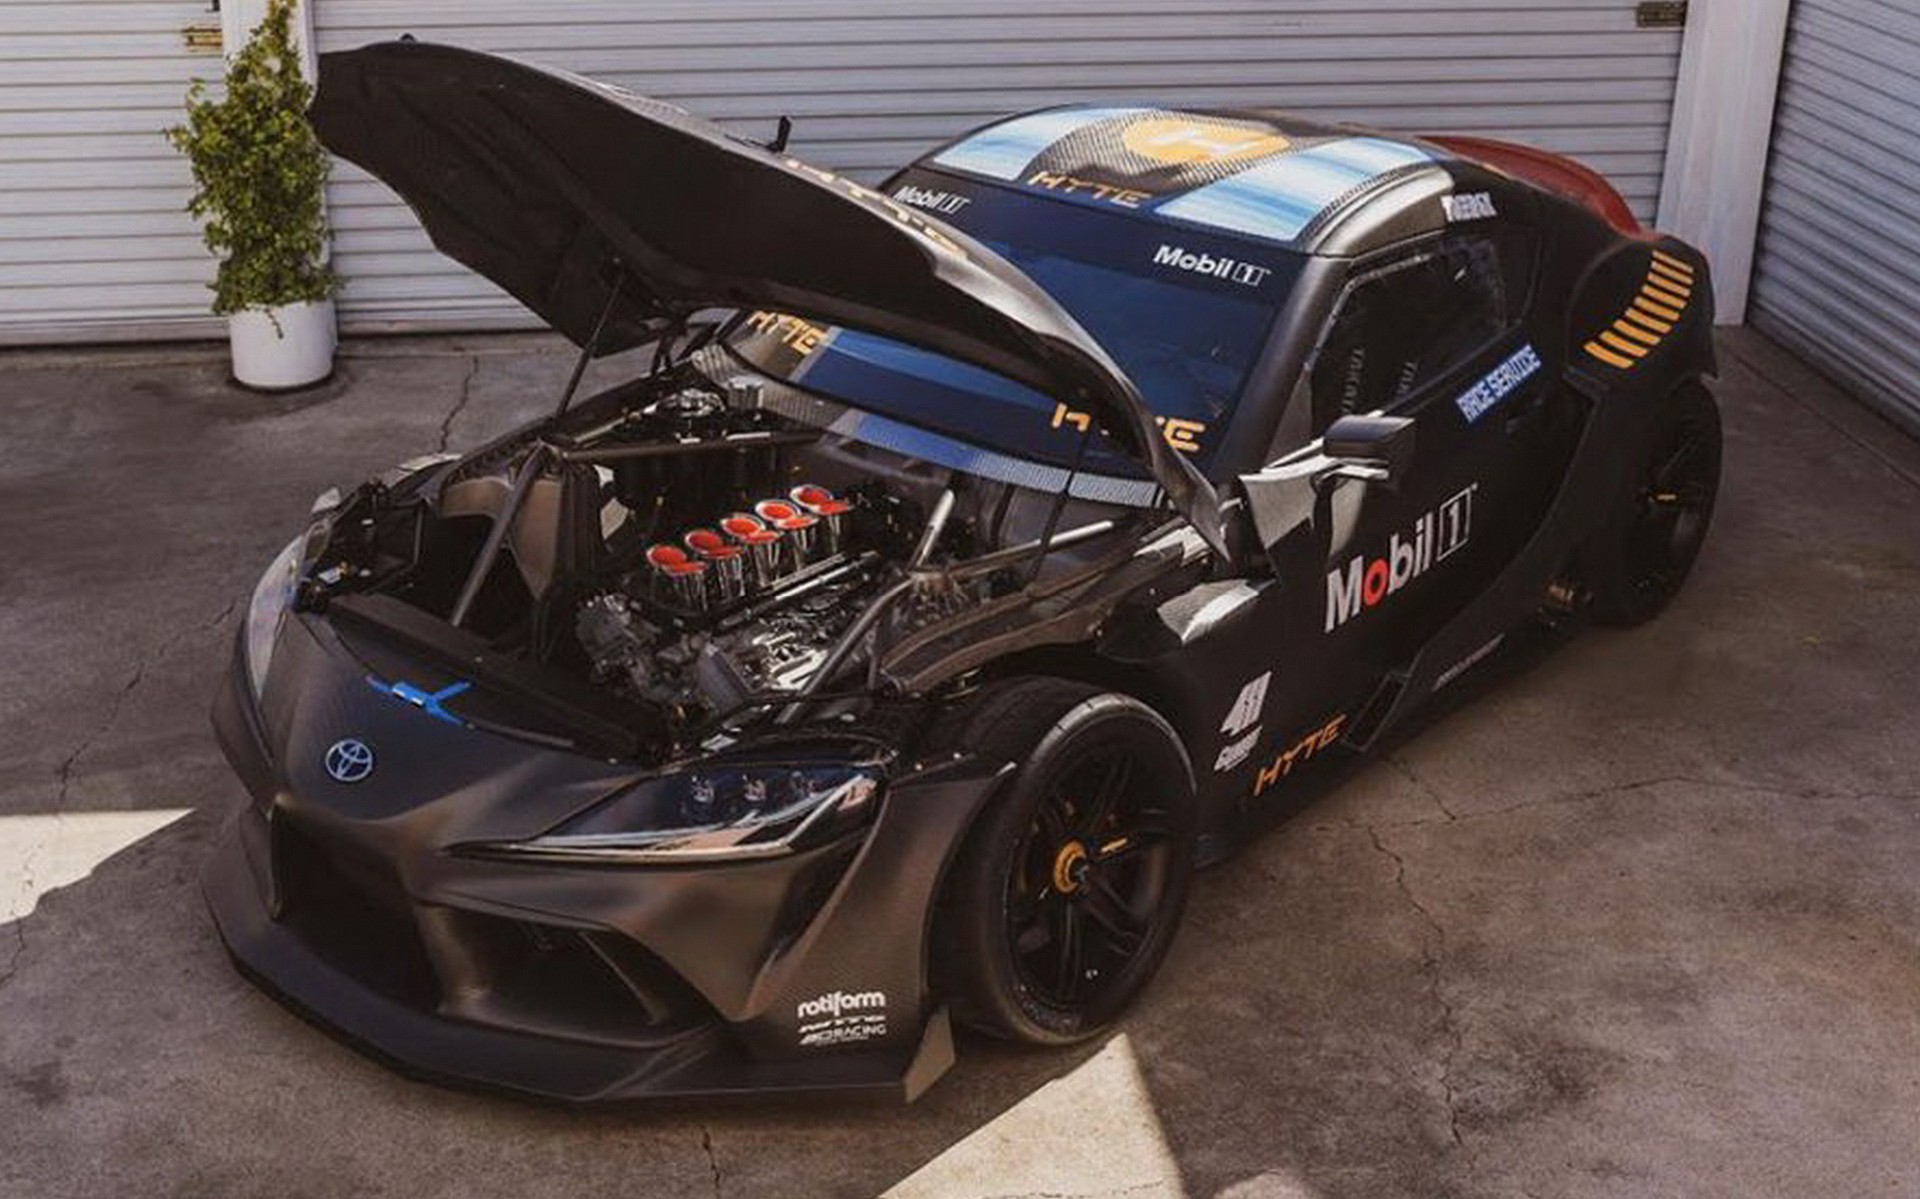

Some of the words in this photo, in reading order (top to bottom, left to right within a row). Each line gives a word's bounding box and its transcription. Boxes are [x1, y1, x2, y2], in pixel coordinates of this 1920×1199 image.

[893, 186, 948, 208] Mobil
[1153, 245, 1235, 279] Mobil
[1325, 511, 1434, 634] Mobil
[1254, 713, 1347, 797] HYTE
[798, 990, 886, 1018] rotiform
